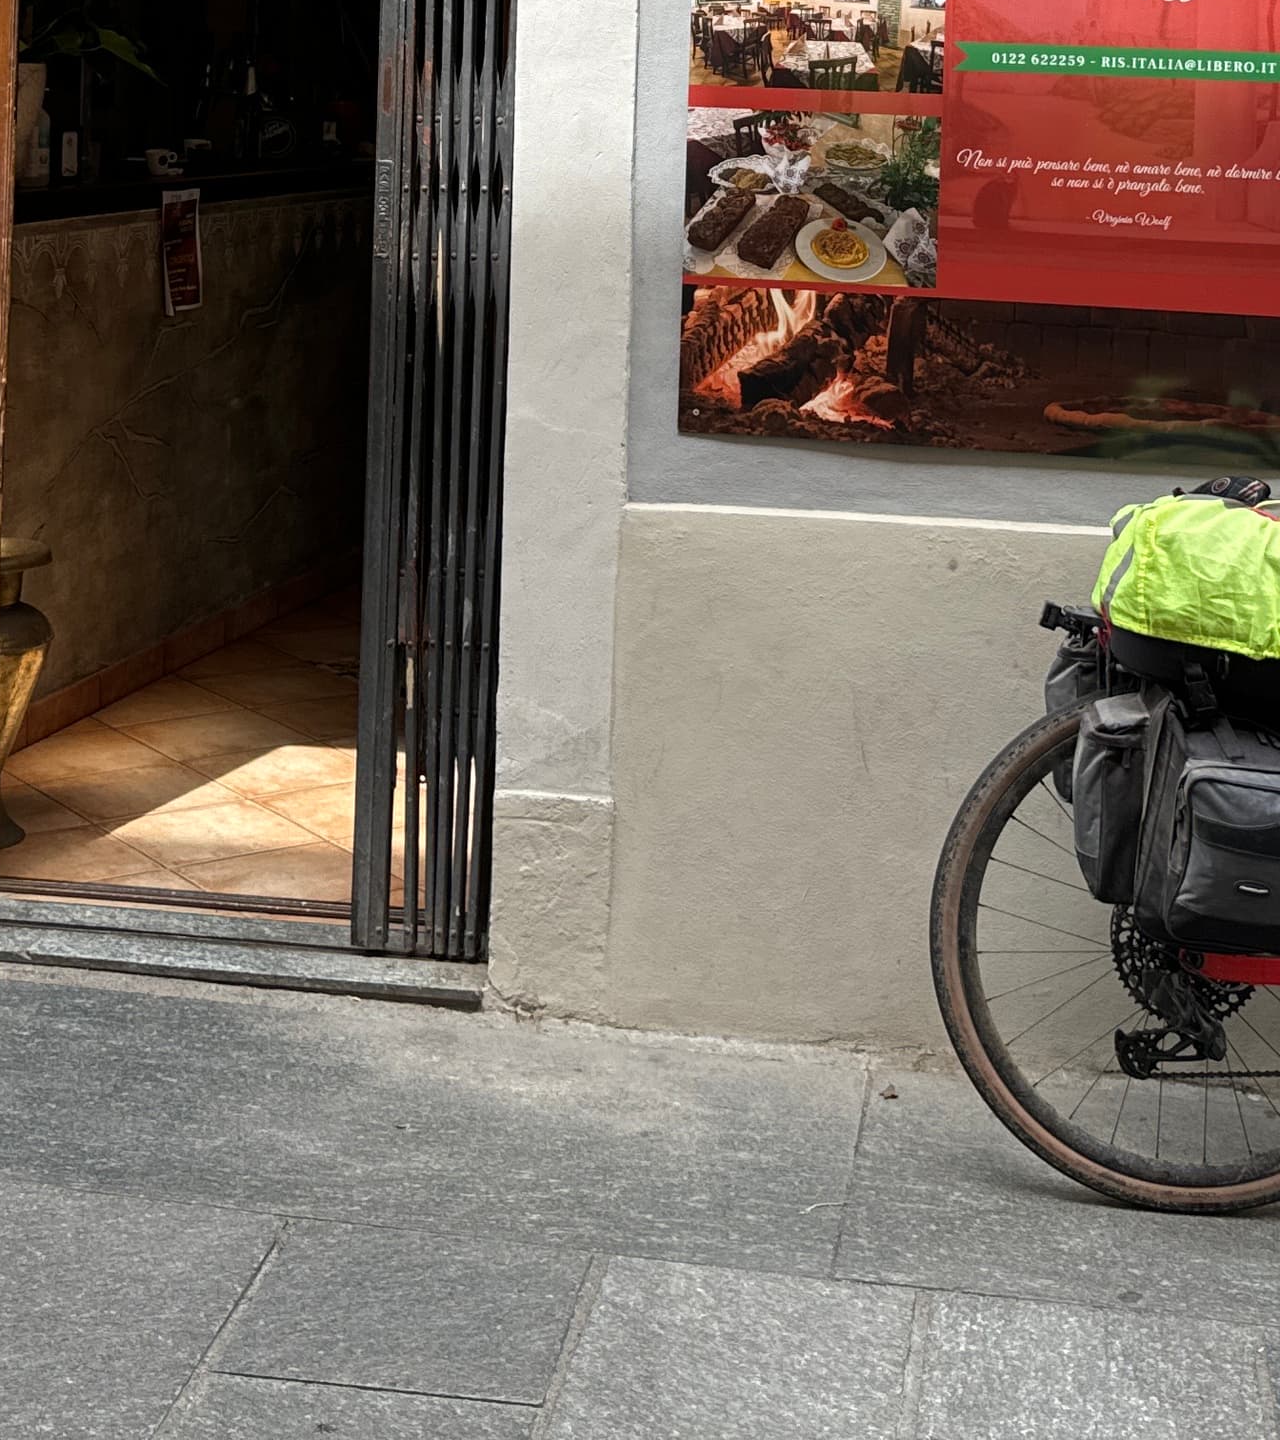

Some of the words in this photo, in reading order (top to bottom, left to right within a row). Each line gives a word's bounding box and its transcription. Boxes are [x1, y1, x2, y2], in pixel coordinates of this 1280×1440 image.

[991, 52, 1026, 65] 0122
[1031, 53, 1085, 67] 622259
[1101, 56, 1277, 75] RIS.ITALIA@LIBERO.IT
[956, 148, 993, 169] Non
[996, 156, 1008, 168] si
[1008, 157, 1033, 173] può
[1033, 160, 1081, 175] pensare
[1083, 158, 1111, 173] bene,
[1133, 163, 1170, 175] amare
[1174, 162, 1202, 178] bene,
[1225, 164, 1272, 180] dormire
[1051, 177, 1064, 187] se
[1066, 178, 1090, 189] non
[1092, 178, 1104, 189] si
[1114, 178, 1171, 197] pranzato
[1175, 179, 1205, 195] bene.
[1091, 209, 1133, 227] Virginia
[1134, 211, 1173, 231] Woolf
